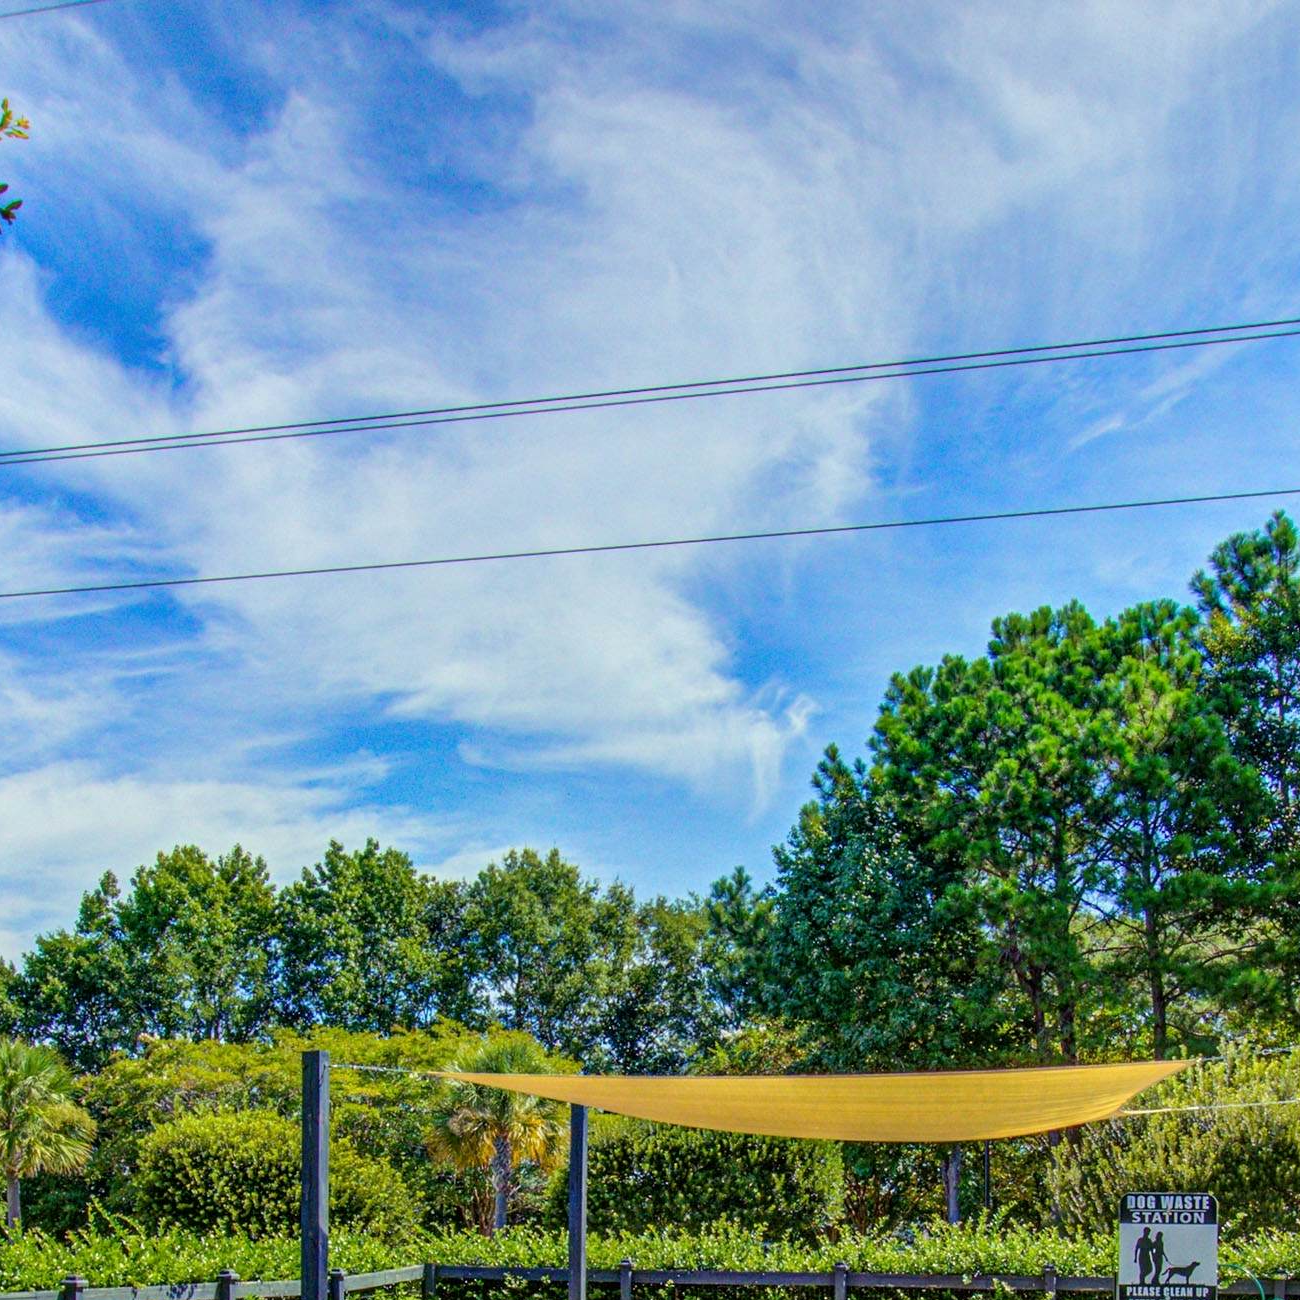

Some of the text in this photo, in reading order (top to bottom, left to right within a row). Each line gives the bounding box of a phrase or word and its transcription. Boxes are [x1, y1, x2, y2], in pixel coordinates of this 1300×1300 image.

[1127, 1195, 1210, 1210] DOG WASTE
[1132, 1212, 1204, 1224] STATION
[1126, 1286, 1208, 1296] PLEASE CLEAN UP
